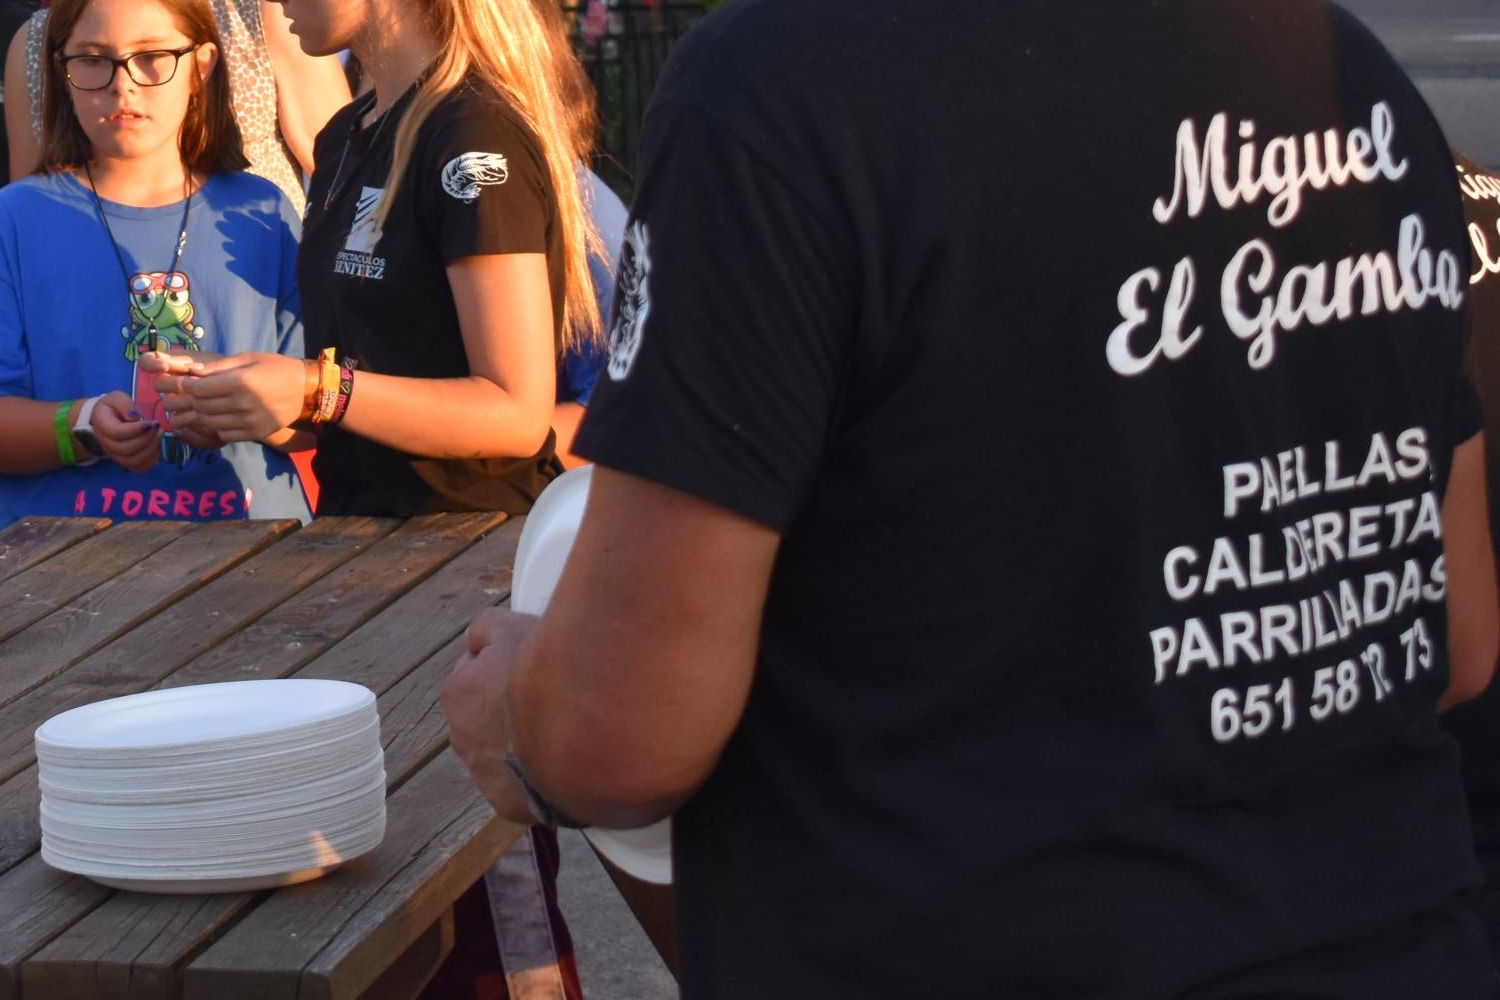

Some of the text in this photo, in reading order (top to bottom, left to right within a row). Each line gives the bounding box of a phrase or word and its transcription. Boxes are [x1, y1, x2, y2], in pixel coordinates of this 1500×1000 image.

[1152, 100, 1409, 228] Miguel
[1105, 213, 1463, 376] El Gamba
[1210, 676, 1294, 743] 651
[1309, 656, 1361, 722] 58
